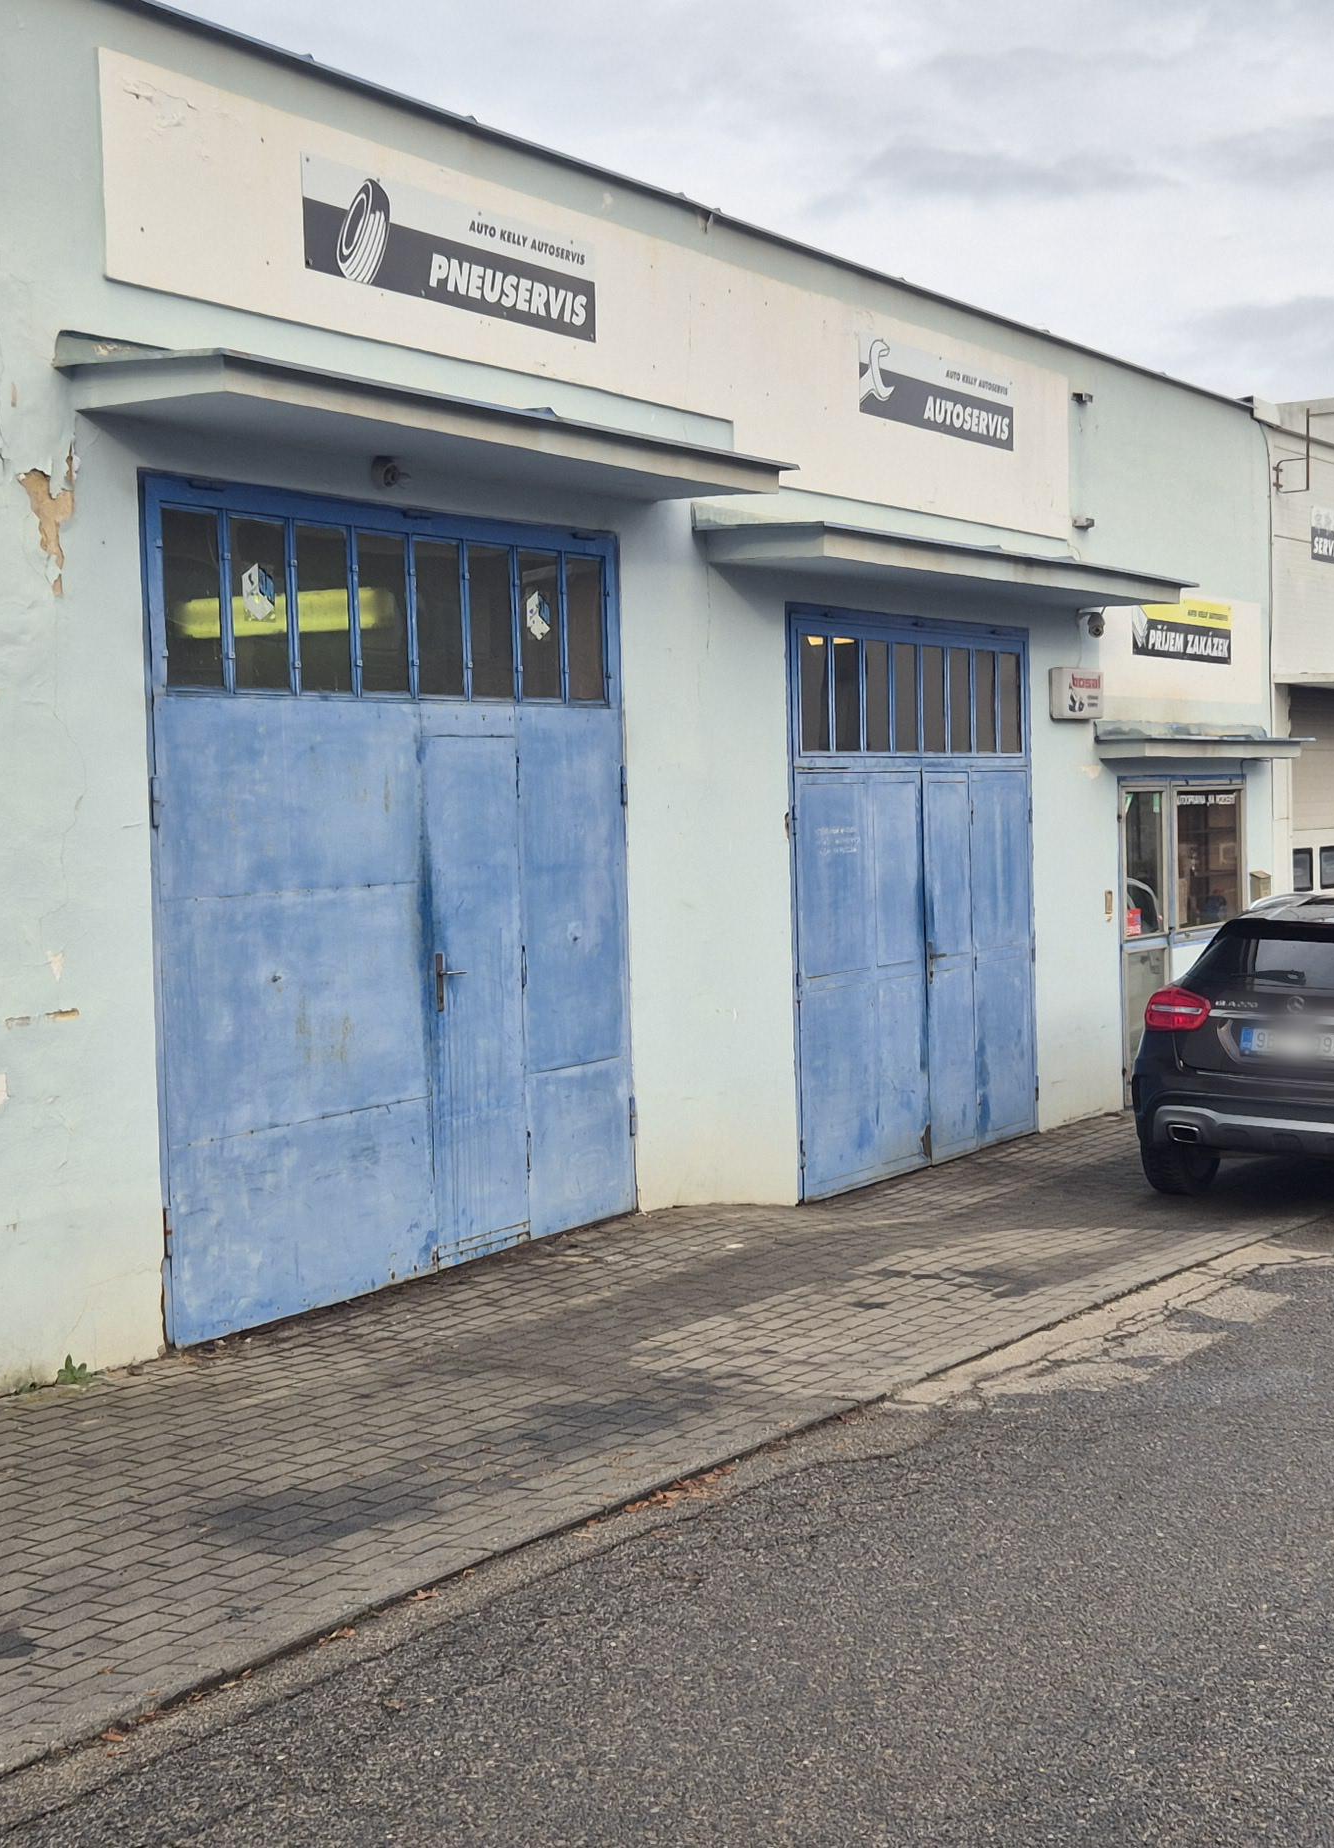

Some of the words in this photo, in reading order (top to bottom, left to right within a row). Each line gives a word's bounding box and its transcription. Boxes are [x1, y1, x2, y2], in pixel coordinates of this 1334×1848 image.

[468, 220, 496, 238] AUTO
[499, 229, 528, 248] KELLY
[530, 239, 586, 266] AUTOSERVIS
[428, 253, 588, 327] PNEUSERVIS
[945, 369, 961, 381] AUTO
[961, 374, 978, 387] KELLY
[978, 380, 1009, 396] AUTOSERVIS
[923, 395, 1010, 441] AUTOSERVIS
[1148, 624, 1185, 653] PŘÍJEM
[1185, 631, 1229, 658] ZAKÁZEK
